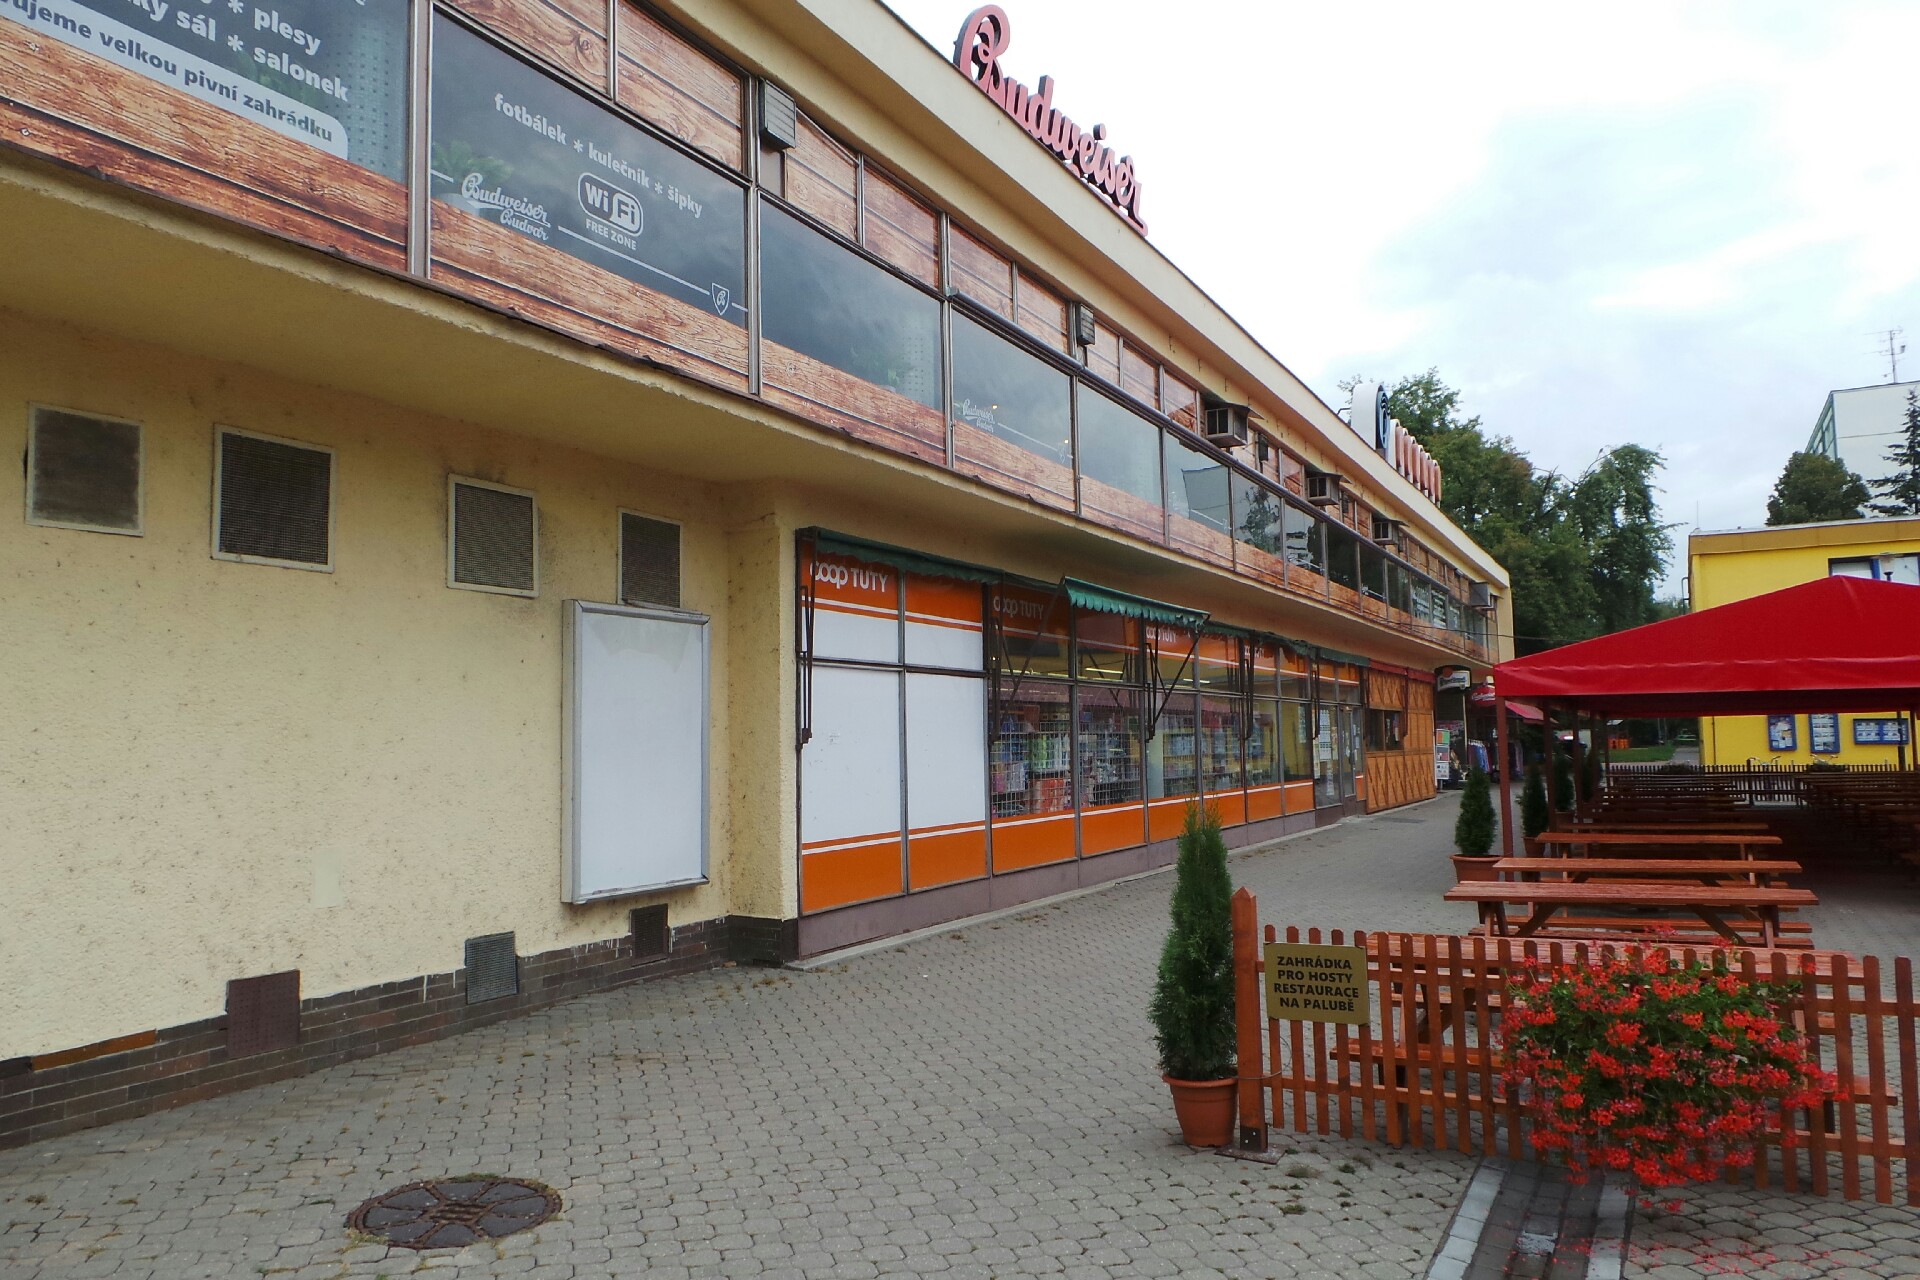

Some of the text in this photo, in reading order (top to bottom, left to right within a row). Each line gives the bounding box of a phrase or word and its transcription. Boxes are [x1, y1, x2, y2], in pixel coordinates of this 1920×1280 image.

[254, 8, 321, 55] plesy
[0, 0, 92, 39] ujeme
[99, 32, 177, 75] velkou
[184, 69, 237, 101] pivní
[243, 94, 332, 142] zahrádku
[177, 10, 216, 41] sál
[253, 47, 349, 101] salonek
[953, 4, 1148, 237] Budweiser
[494, 93, 702, 219] fotbálek kulečník šipky
[462, 173, 551, 228] Budweiser
[500, 208, 549, 240] Budvar
[586, 219, 637, 250] FREE ZONE
[851, 567, 888, 592] TUTY
[1277, 955, 1352, 970] ZAHRÁDKA
[1278, 969, 1353, 984] PRO HOSTY
[1274, 983, 1359, 998] RESTAURACE
[1280, 997, 1355, 1012] NA PALUBĚ
